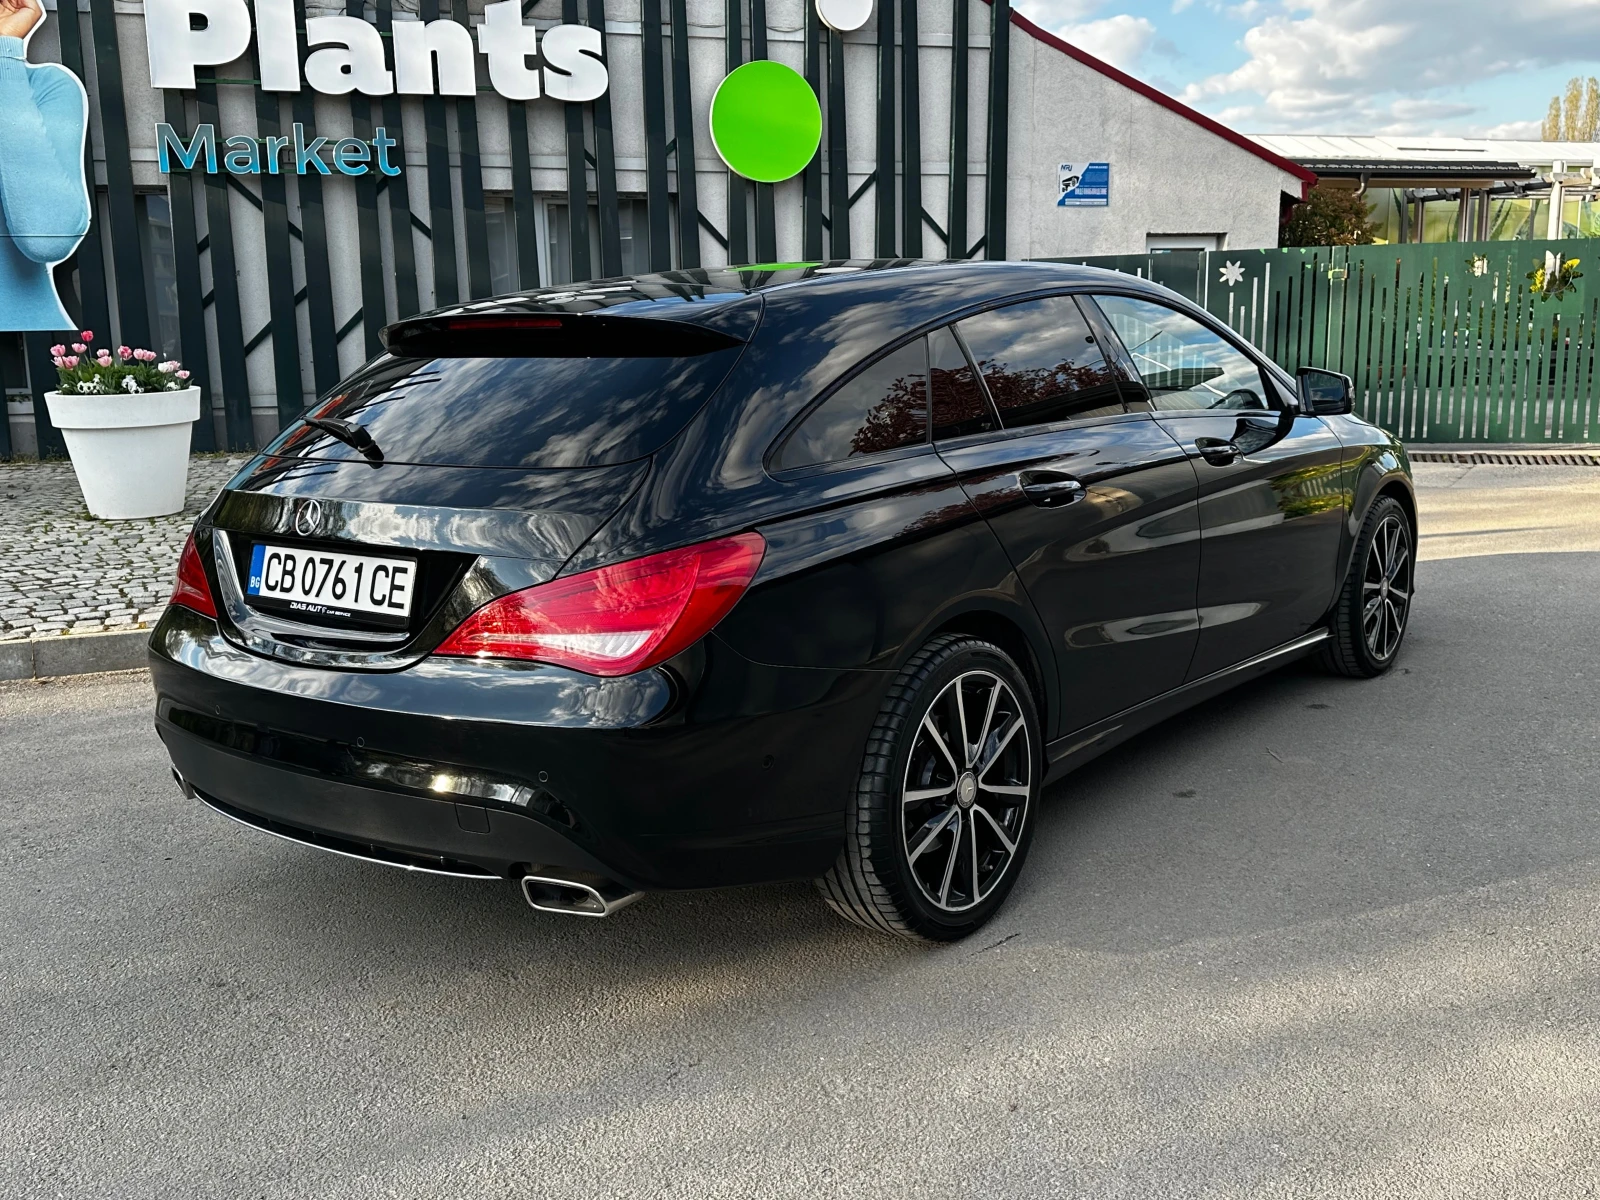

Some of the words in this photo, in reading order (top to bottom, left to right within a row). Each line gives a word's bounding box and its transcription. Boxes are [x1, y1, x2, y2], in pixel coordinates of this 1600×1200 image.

[144, 0, 609, 101] Plants
[155, 122, 401, 175] Market
[250, 575, 261, 588] BG
[290, 602, 306, 610] DIAS
